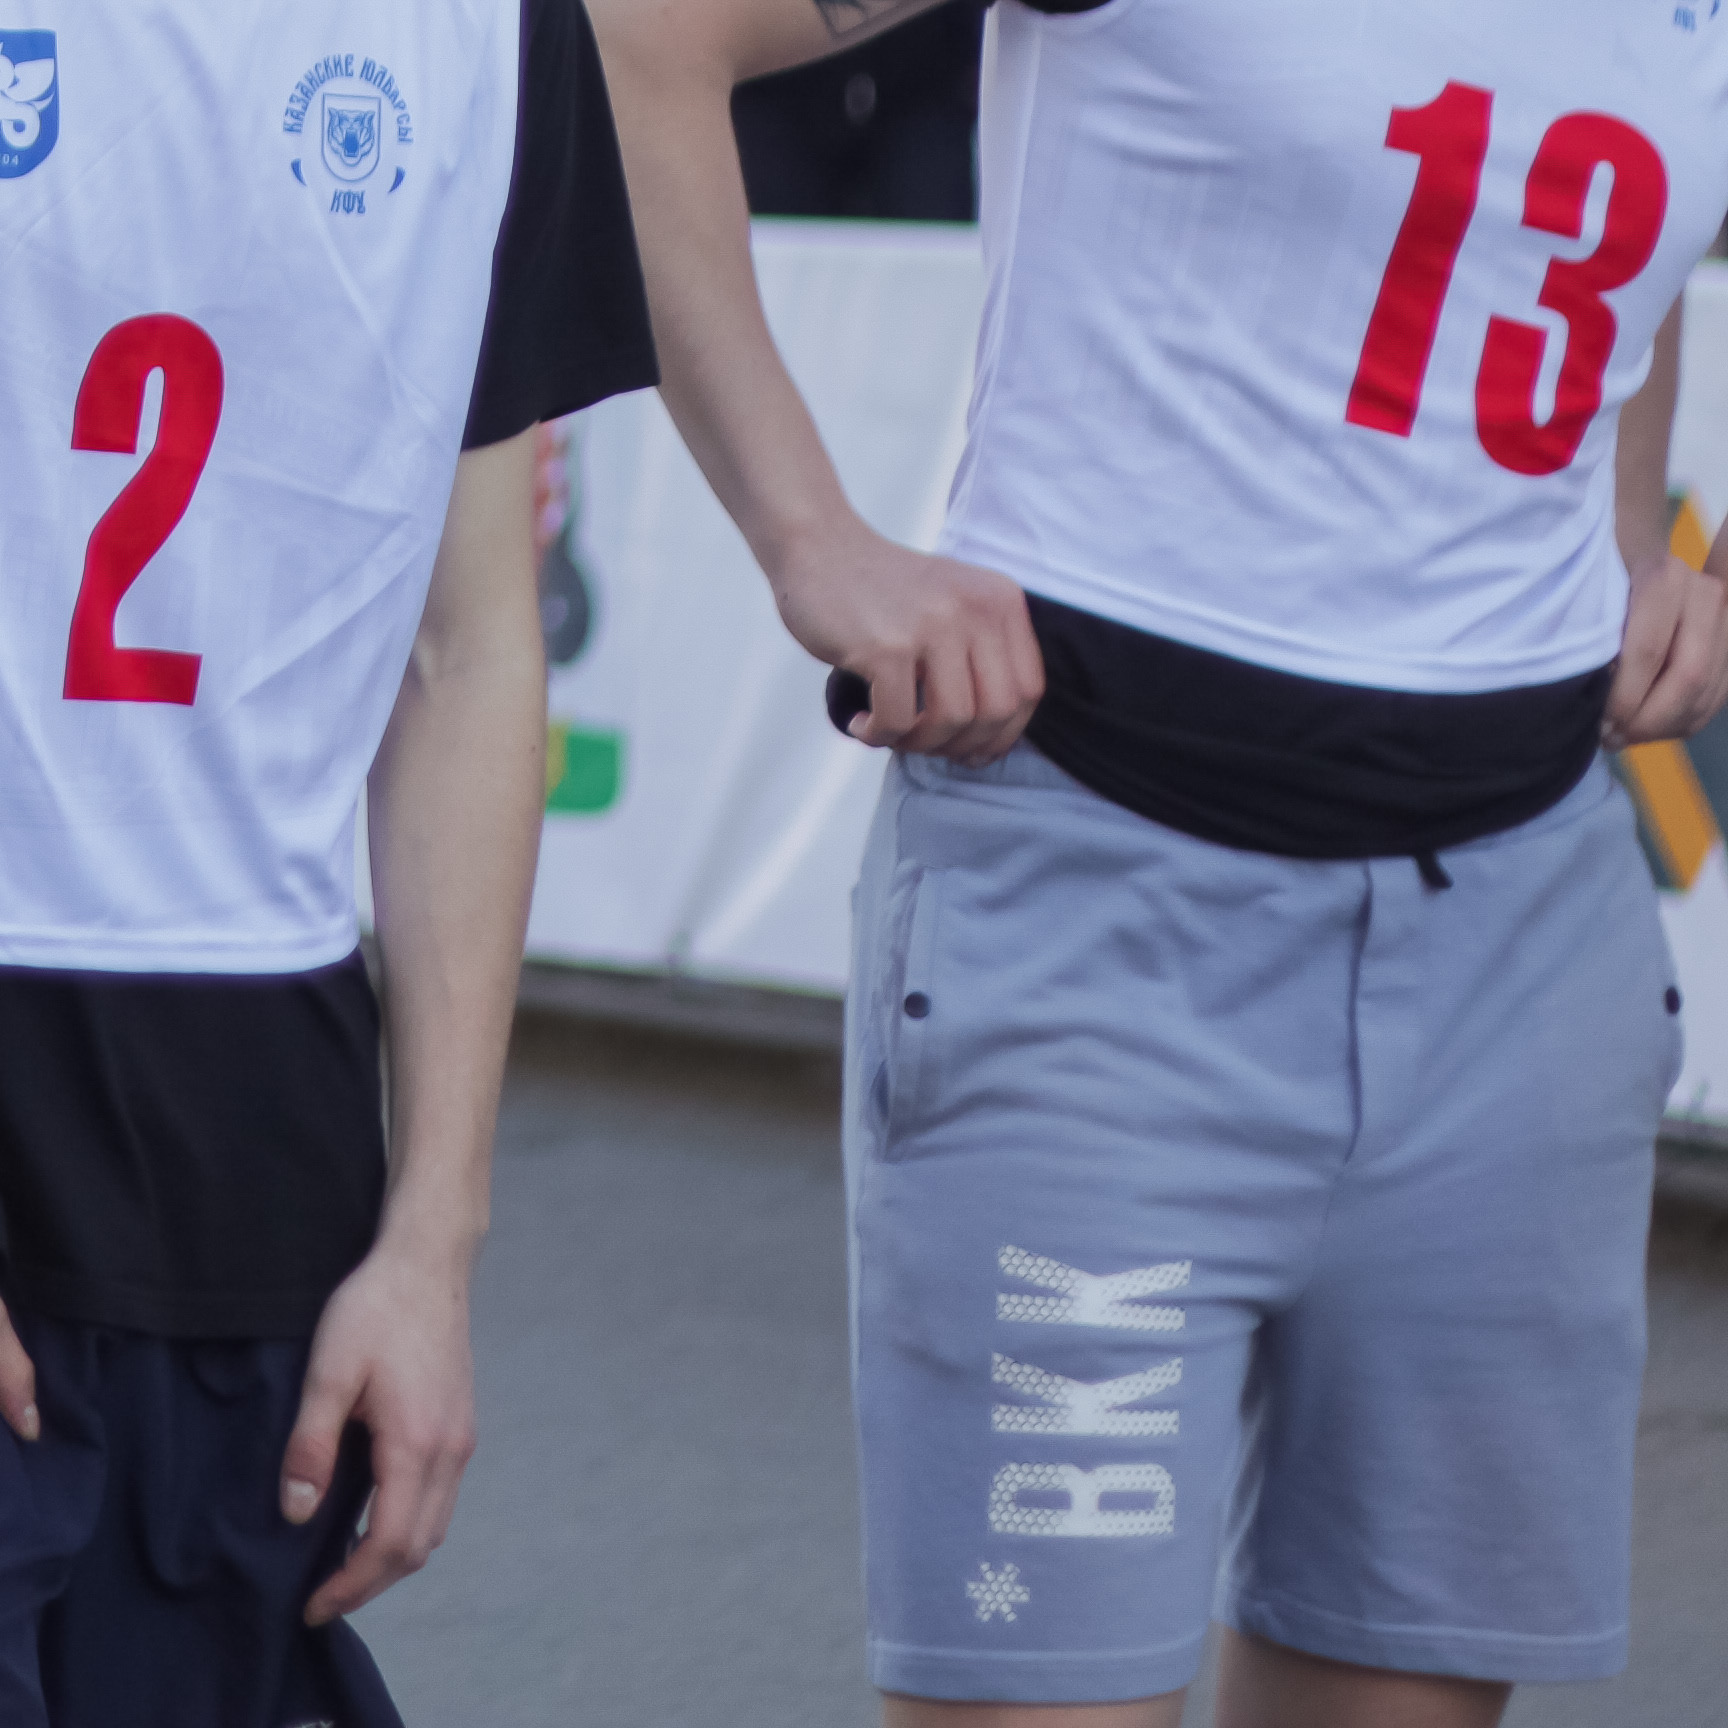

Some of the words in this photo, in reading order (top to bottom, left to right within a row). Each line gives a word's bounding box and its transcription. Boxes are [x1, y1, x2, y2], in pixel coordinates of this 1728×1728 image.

[283, 54, 354, 133] КАЗАНСКИЕ
[360, 57, 413, 143] ЮЛБАРСЫ
[1346, 79, 1669, 476] 13
[63, 313, 224, 706] 2
